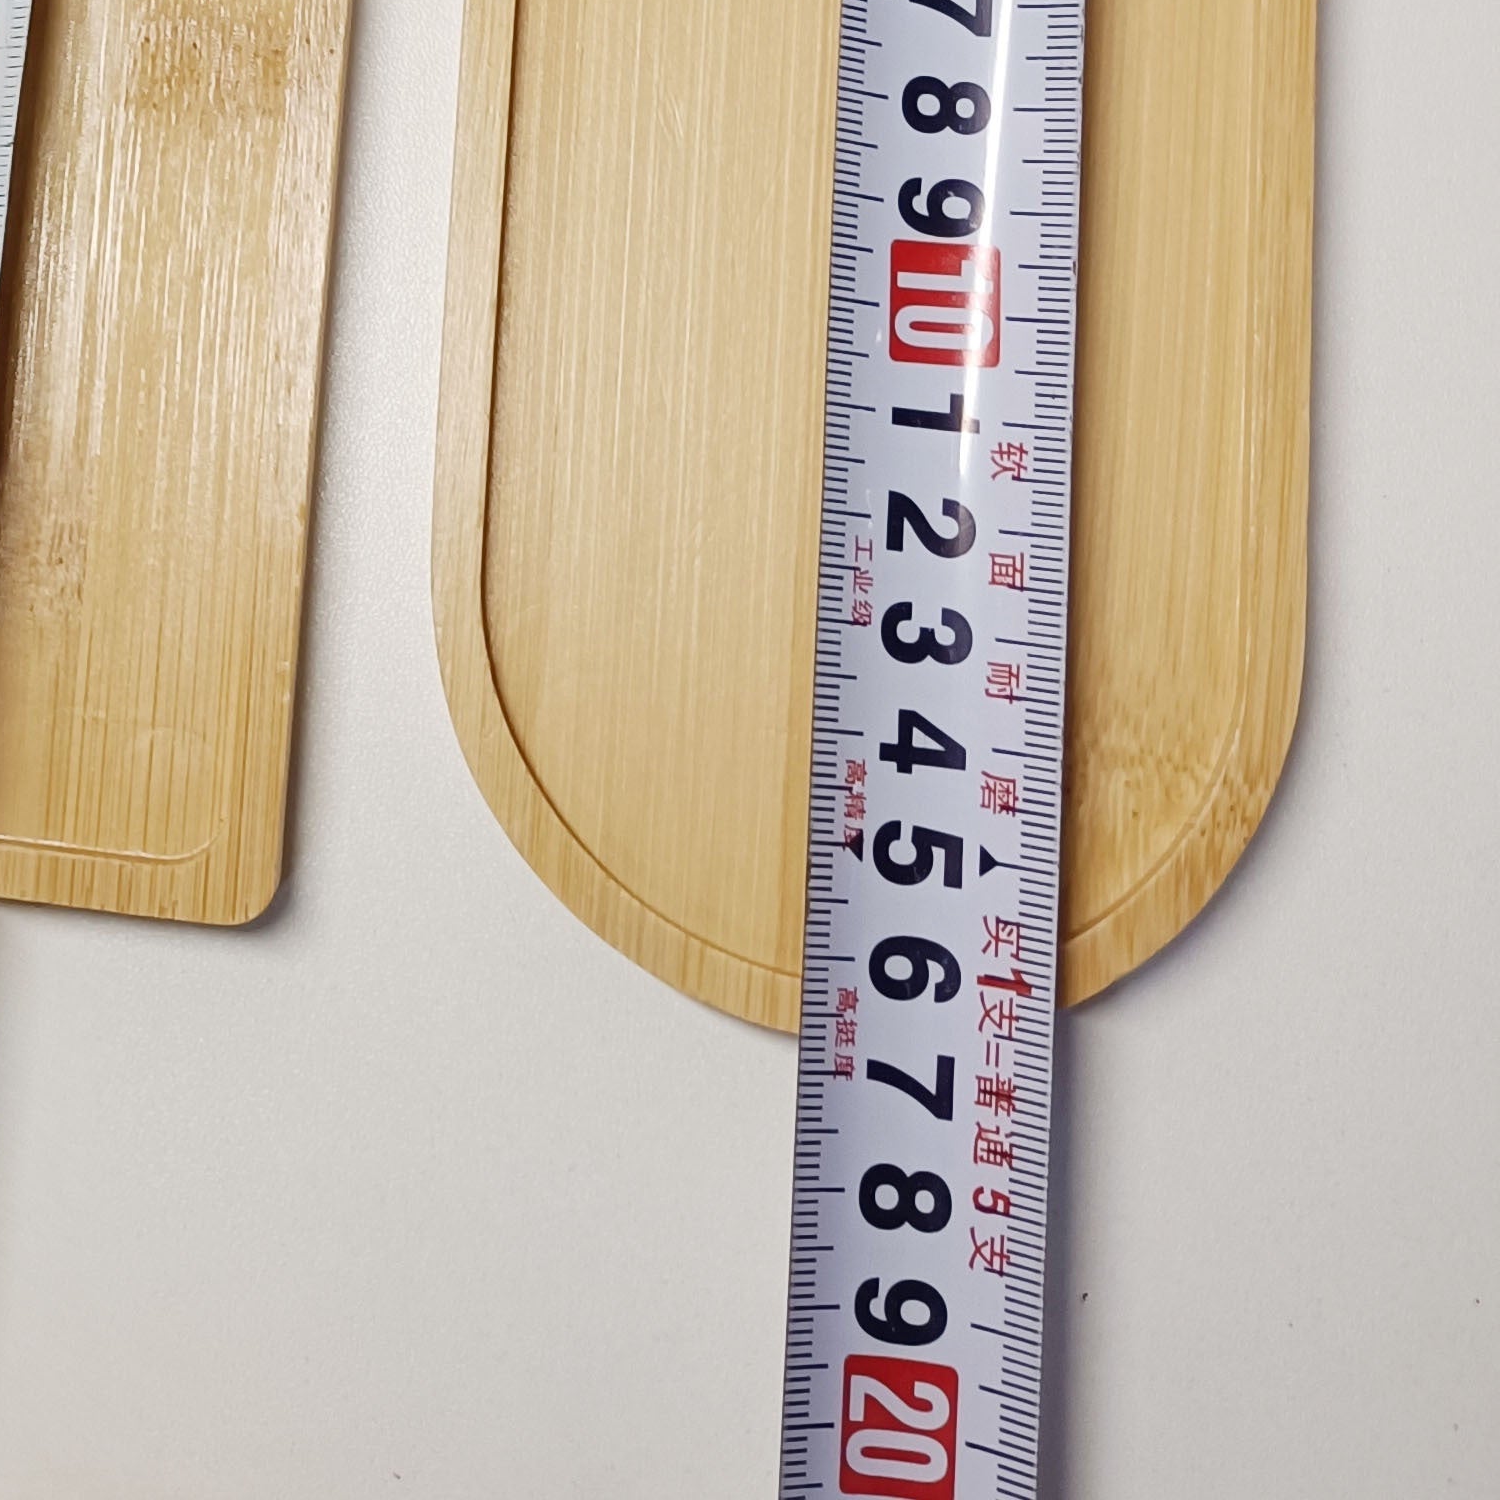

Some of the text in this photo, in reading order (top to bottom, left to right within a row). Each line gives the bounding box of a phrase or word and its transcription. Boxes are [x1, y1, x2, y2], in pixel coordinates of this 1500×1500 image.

[901, 75, 991, 135] 8
[897, 177, 986, 238] 9
[893, 259, 994, 352] 10
[891, 393, 980, 434] 1
[886, 490, 976, 559] 2
[850, 535, 875, 627] 工业级
[880, 601, 973, 665] 3
[879, 708, 967, 775] 4
[872, 820, 964, 889] 5
[868, 935, 962, 1003] 6
[866, 1054, 955, 1121] 7
[858, 1163, 952, 1233] 8
[854, 1277, 948, 1347] 9
[845, 1374, 950, 1484] 20
